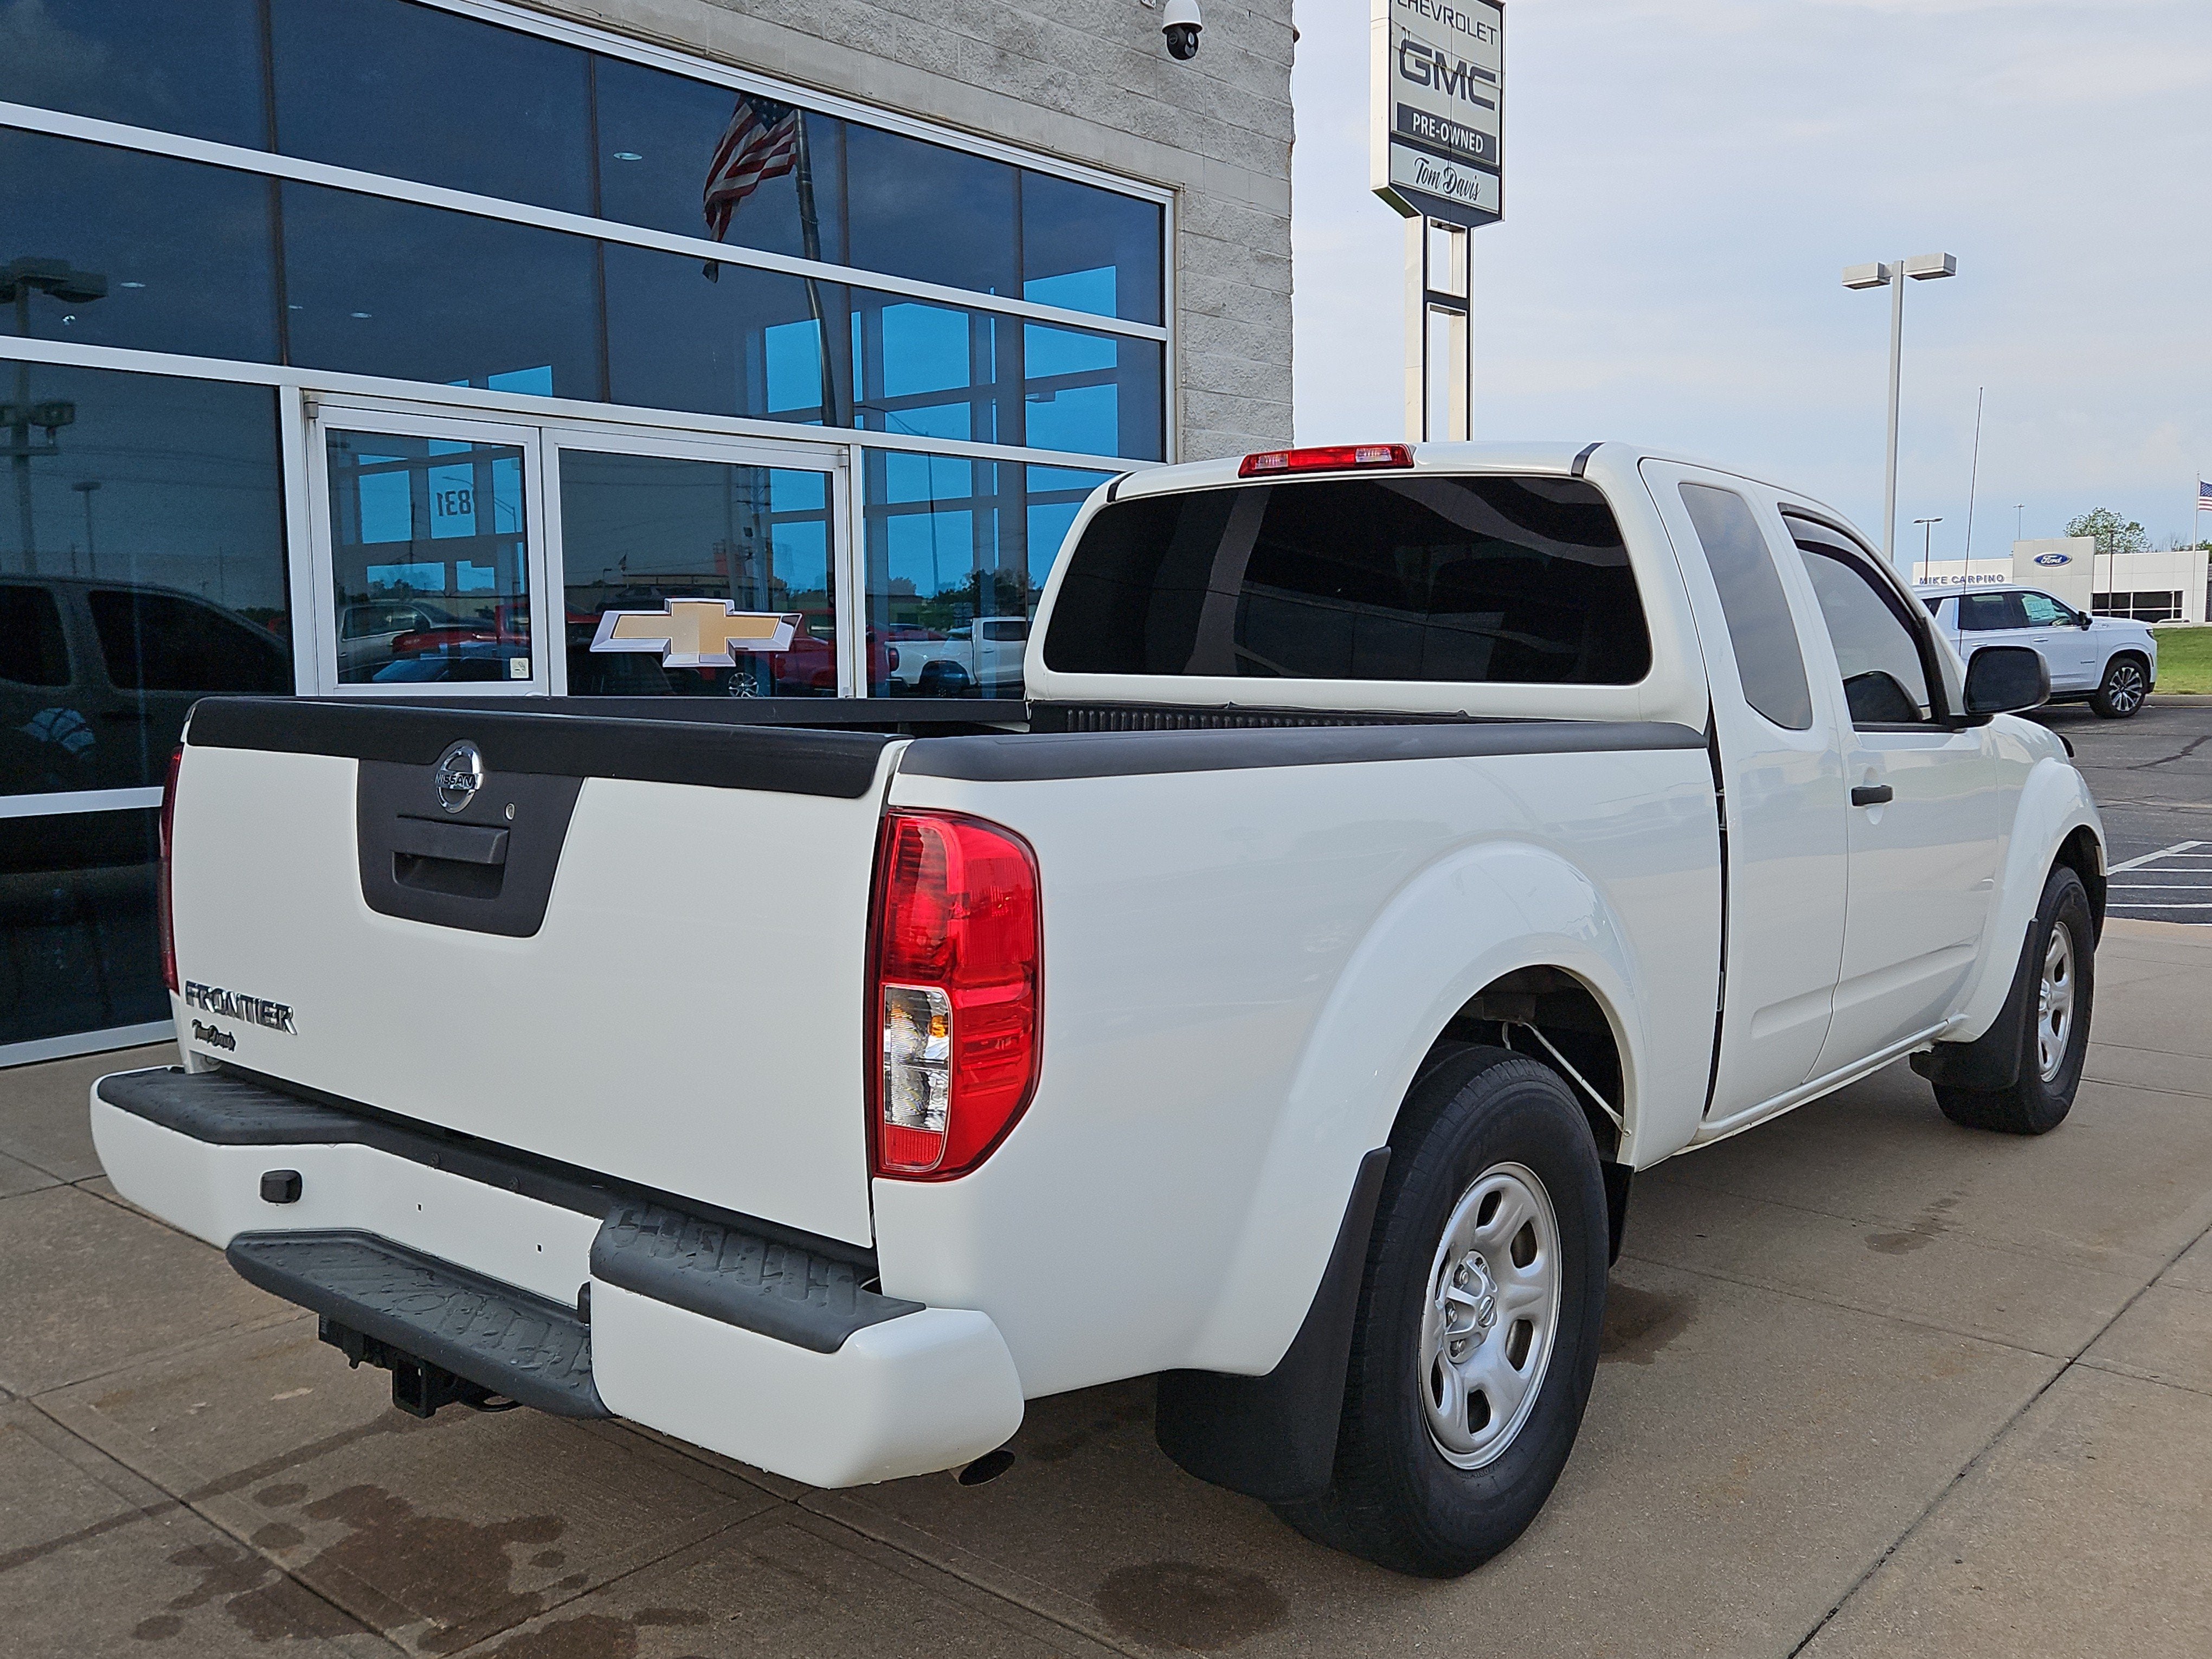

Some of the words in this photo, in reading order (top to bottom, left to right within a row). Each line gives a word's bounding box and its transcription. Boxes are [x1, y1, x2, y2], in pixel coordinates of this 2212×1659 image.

[1399, 38, 1496, 111] GMC
[1412, 112, 1484, 153] PRE-OWNED
[1414, 157, 1442, 190] Tom
[1442, 167, 1481, 201] Davis
[1919, 576, 1948, 584] MIKE
[1952, 574, 2005, 584] CARPINO
[2041, 555, 2063, 564] Ford
[435, 773, 474, 787] NISSAN
[185, 980, 298, 1036] FRONTIER
